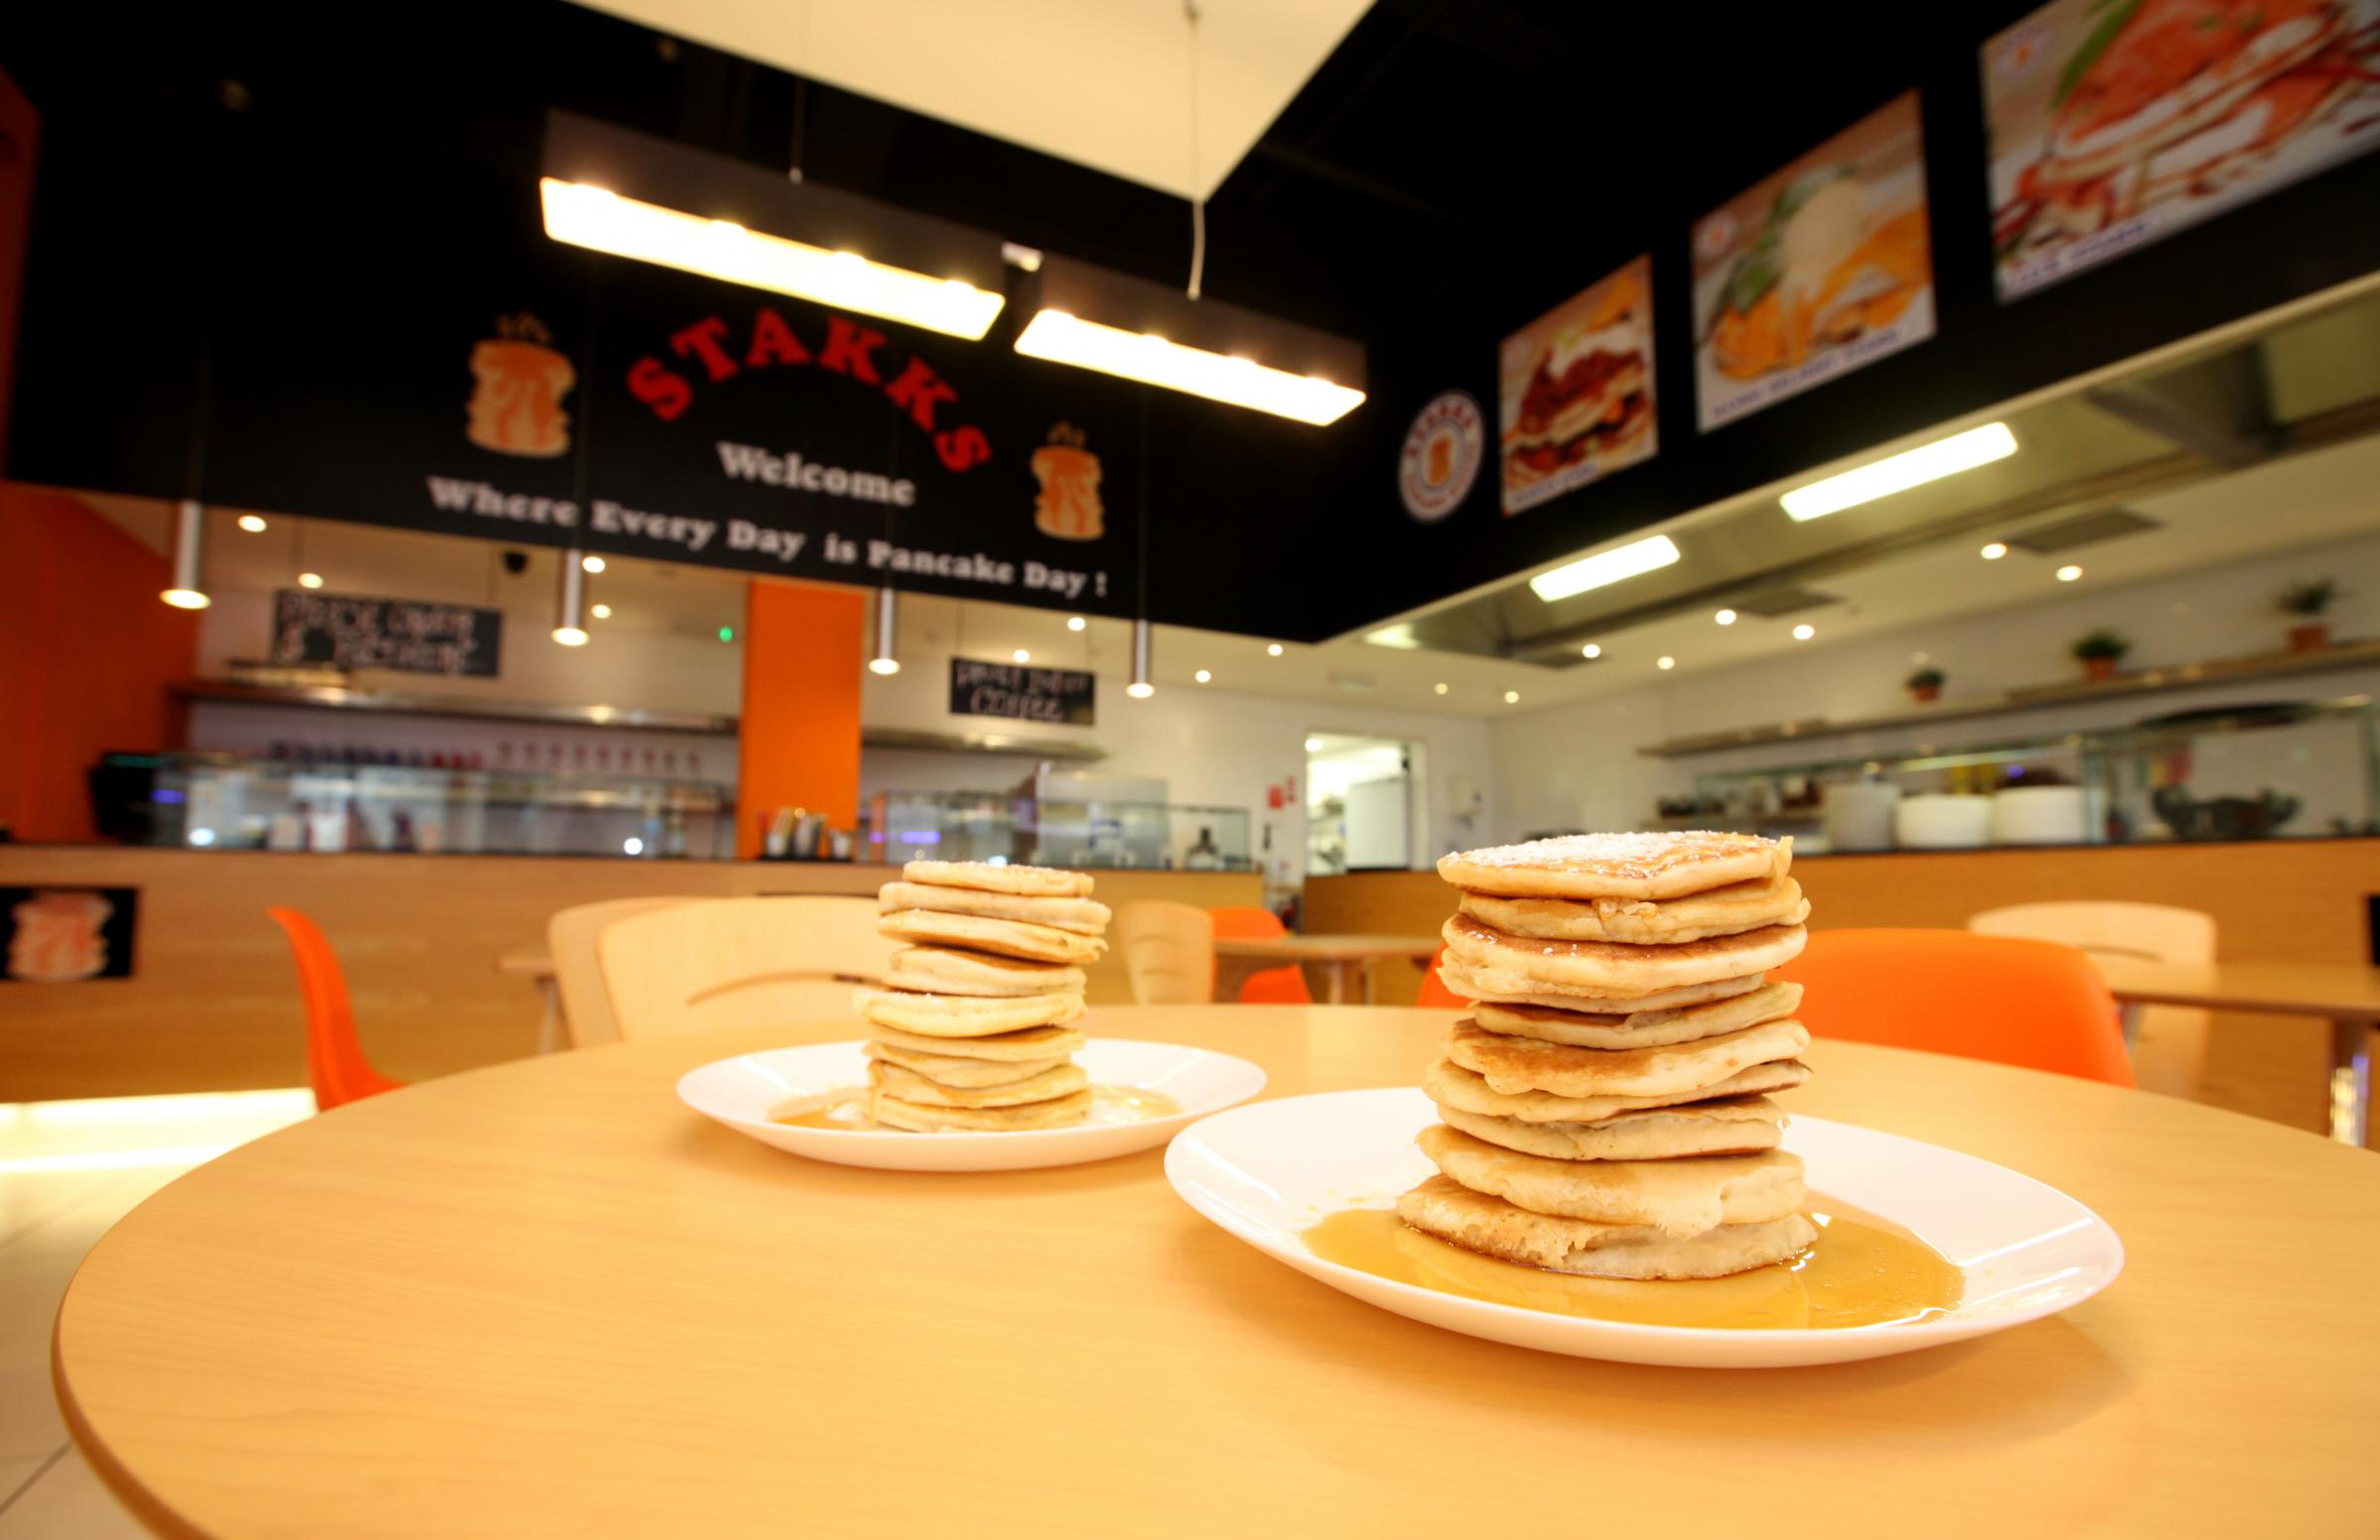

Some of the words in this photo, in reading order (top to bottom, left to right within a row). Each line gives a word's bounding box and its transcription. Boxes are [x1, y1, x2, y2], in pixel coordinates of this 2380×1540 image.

[628, 308, 992, 472] STAKKS
[718, 442, 915, 507] Welcome
[427, 476, 579, 528] Where
[591, 500, 717, 551] Every
[727, 519, 806, 562] Day
[823, 533, 858, 564] is
[867, 539, 1015, 585] Pancake
